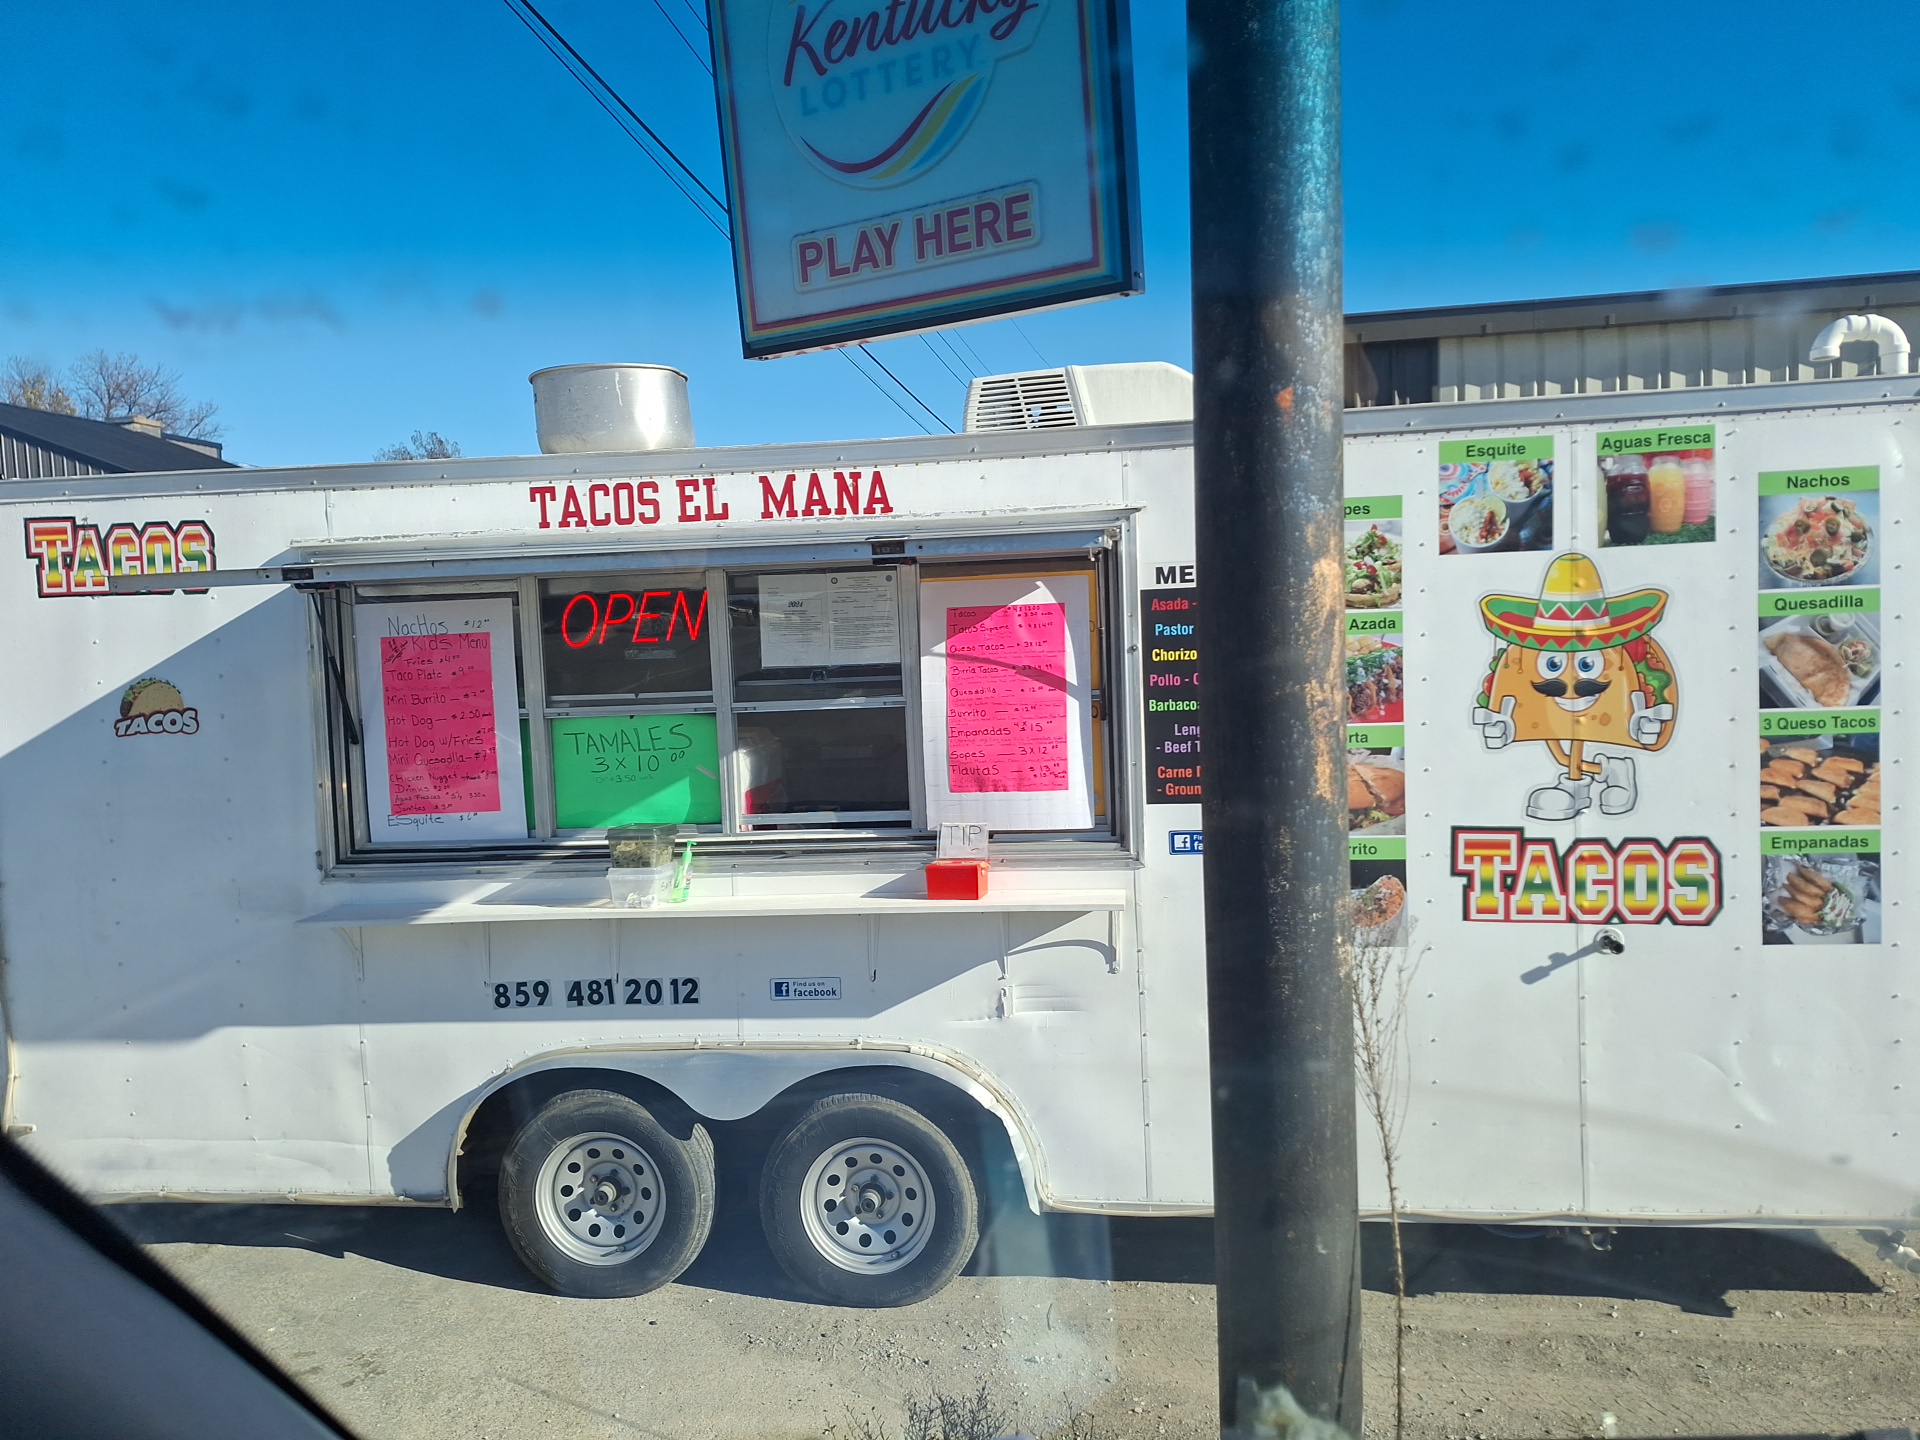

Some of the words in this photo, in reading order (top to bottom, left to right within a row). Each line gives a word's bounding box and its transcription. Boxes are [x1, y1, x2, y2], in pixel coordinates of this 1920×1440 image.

[800, 33, 980, 116] LOTTERY
[799, 222, 900, 283] PLAY
[915, 193, 1032, 260] HERE
[1601, 435, 1652, 452] Aguas
[1657, 431, 1712, 446] Fresca
[1466, 443, 1527, 460] Esquite
[1786, 474, 1850, 489] Nachos
[529, 481, 661, 529] TACOS
[676, 477, 729, 523] EL
[758, 471, 894, 519] MANA
[1344, 504, 1371, 518] pes
[24, 517, 216, 598] TACOS
[1155, 565, 1195, 584] ME
[1151, 598, 1189, 611] Asada
[1774, 595, 1865, 612] Quesadilla
[561, 590, 708, 648] OPEN
[950, 609, 977, 619] Tacos
[949, 623, 979, 634] Tacos
[1155, 623, 1194, 636] Pastor
[1349, 617, 1396, 631] Azada
[411, 635, 453, 651] Kids
[459, 633, 488, 650] Menu
[404, 657, 434, 667] Fries
[1151, 648, 1198, 661] Chorizo
[386, 669, 413, 682] Taco
[416, 668, 443, 681] Plate
[950, 665, 977, 676] Birria
[978, 665, 999, 674] Tacos
[1149, 673, 1181, 687] Pollo
[387, 694, 408, 706] Mini
[411, 692, 446, 706] Burrito
[948, 708, 987, 718] Burrito
[114, 708, 199, 738] TACOS
[387, 714, 409, 726] Hot
[411, 715, 434, 732] Dog
[1763, 716, 1771, 730] 3
[1777, 716, 1828, 731] Queso
[1831, 714, 1877, 728] Tacos
[388, 735, 410, 748] Hot
[414, 735, 436, 754] Dog
[563, 723, 693, 755] TAMALES
[1165, 741, 1191, 753] Beef
[388, 753, 410, 766] Mini
[591, 757, 609, 773] 3
[1157, 766, 1193, 778] Carne
[944, 825, 982, 846] TIP
[1771, 834, 1869, 851] Empanadas
[1348, 842, 1378, 855] rito
[1451, 825, 1723, 926] TACOS
[493, 981, 550, 1008] 859
[566, 979, 615, 1006] 481
[793, 987, 837, 997] facebook
